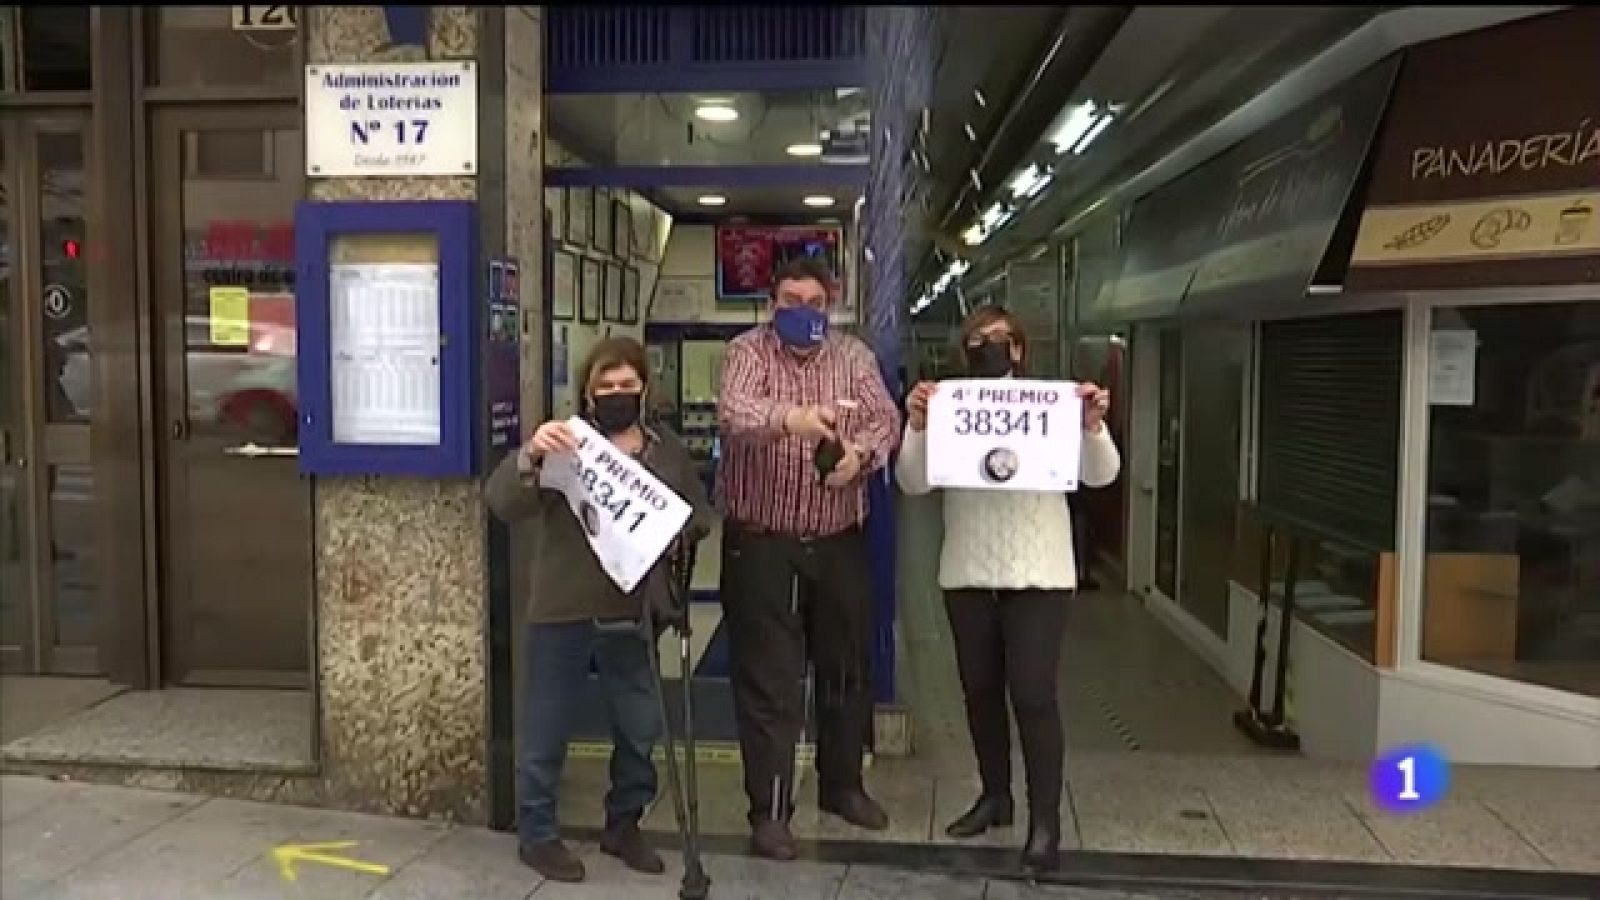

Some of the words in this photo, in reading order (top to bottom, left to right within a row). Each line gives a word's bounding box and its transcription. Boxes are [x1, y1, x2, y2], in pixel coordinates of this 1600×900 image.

[339, 95, 361, 110] de
[392, 120, 429, 143] 17
[977, 387, 1060, 404] PREMIO
[954, 407, 1049, 438] 38341
[594, 451, 669, 511] PREMIO
